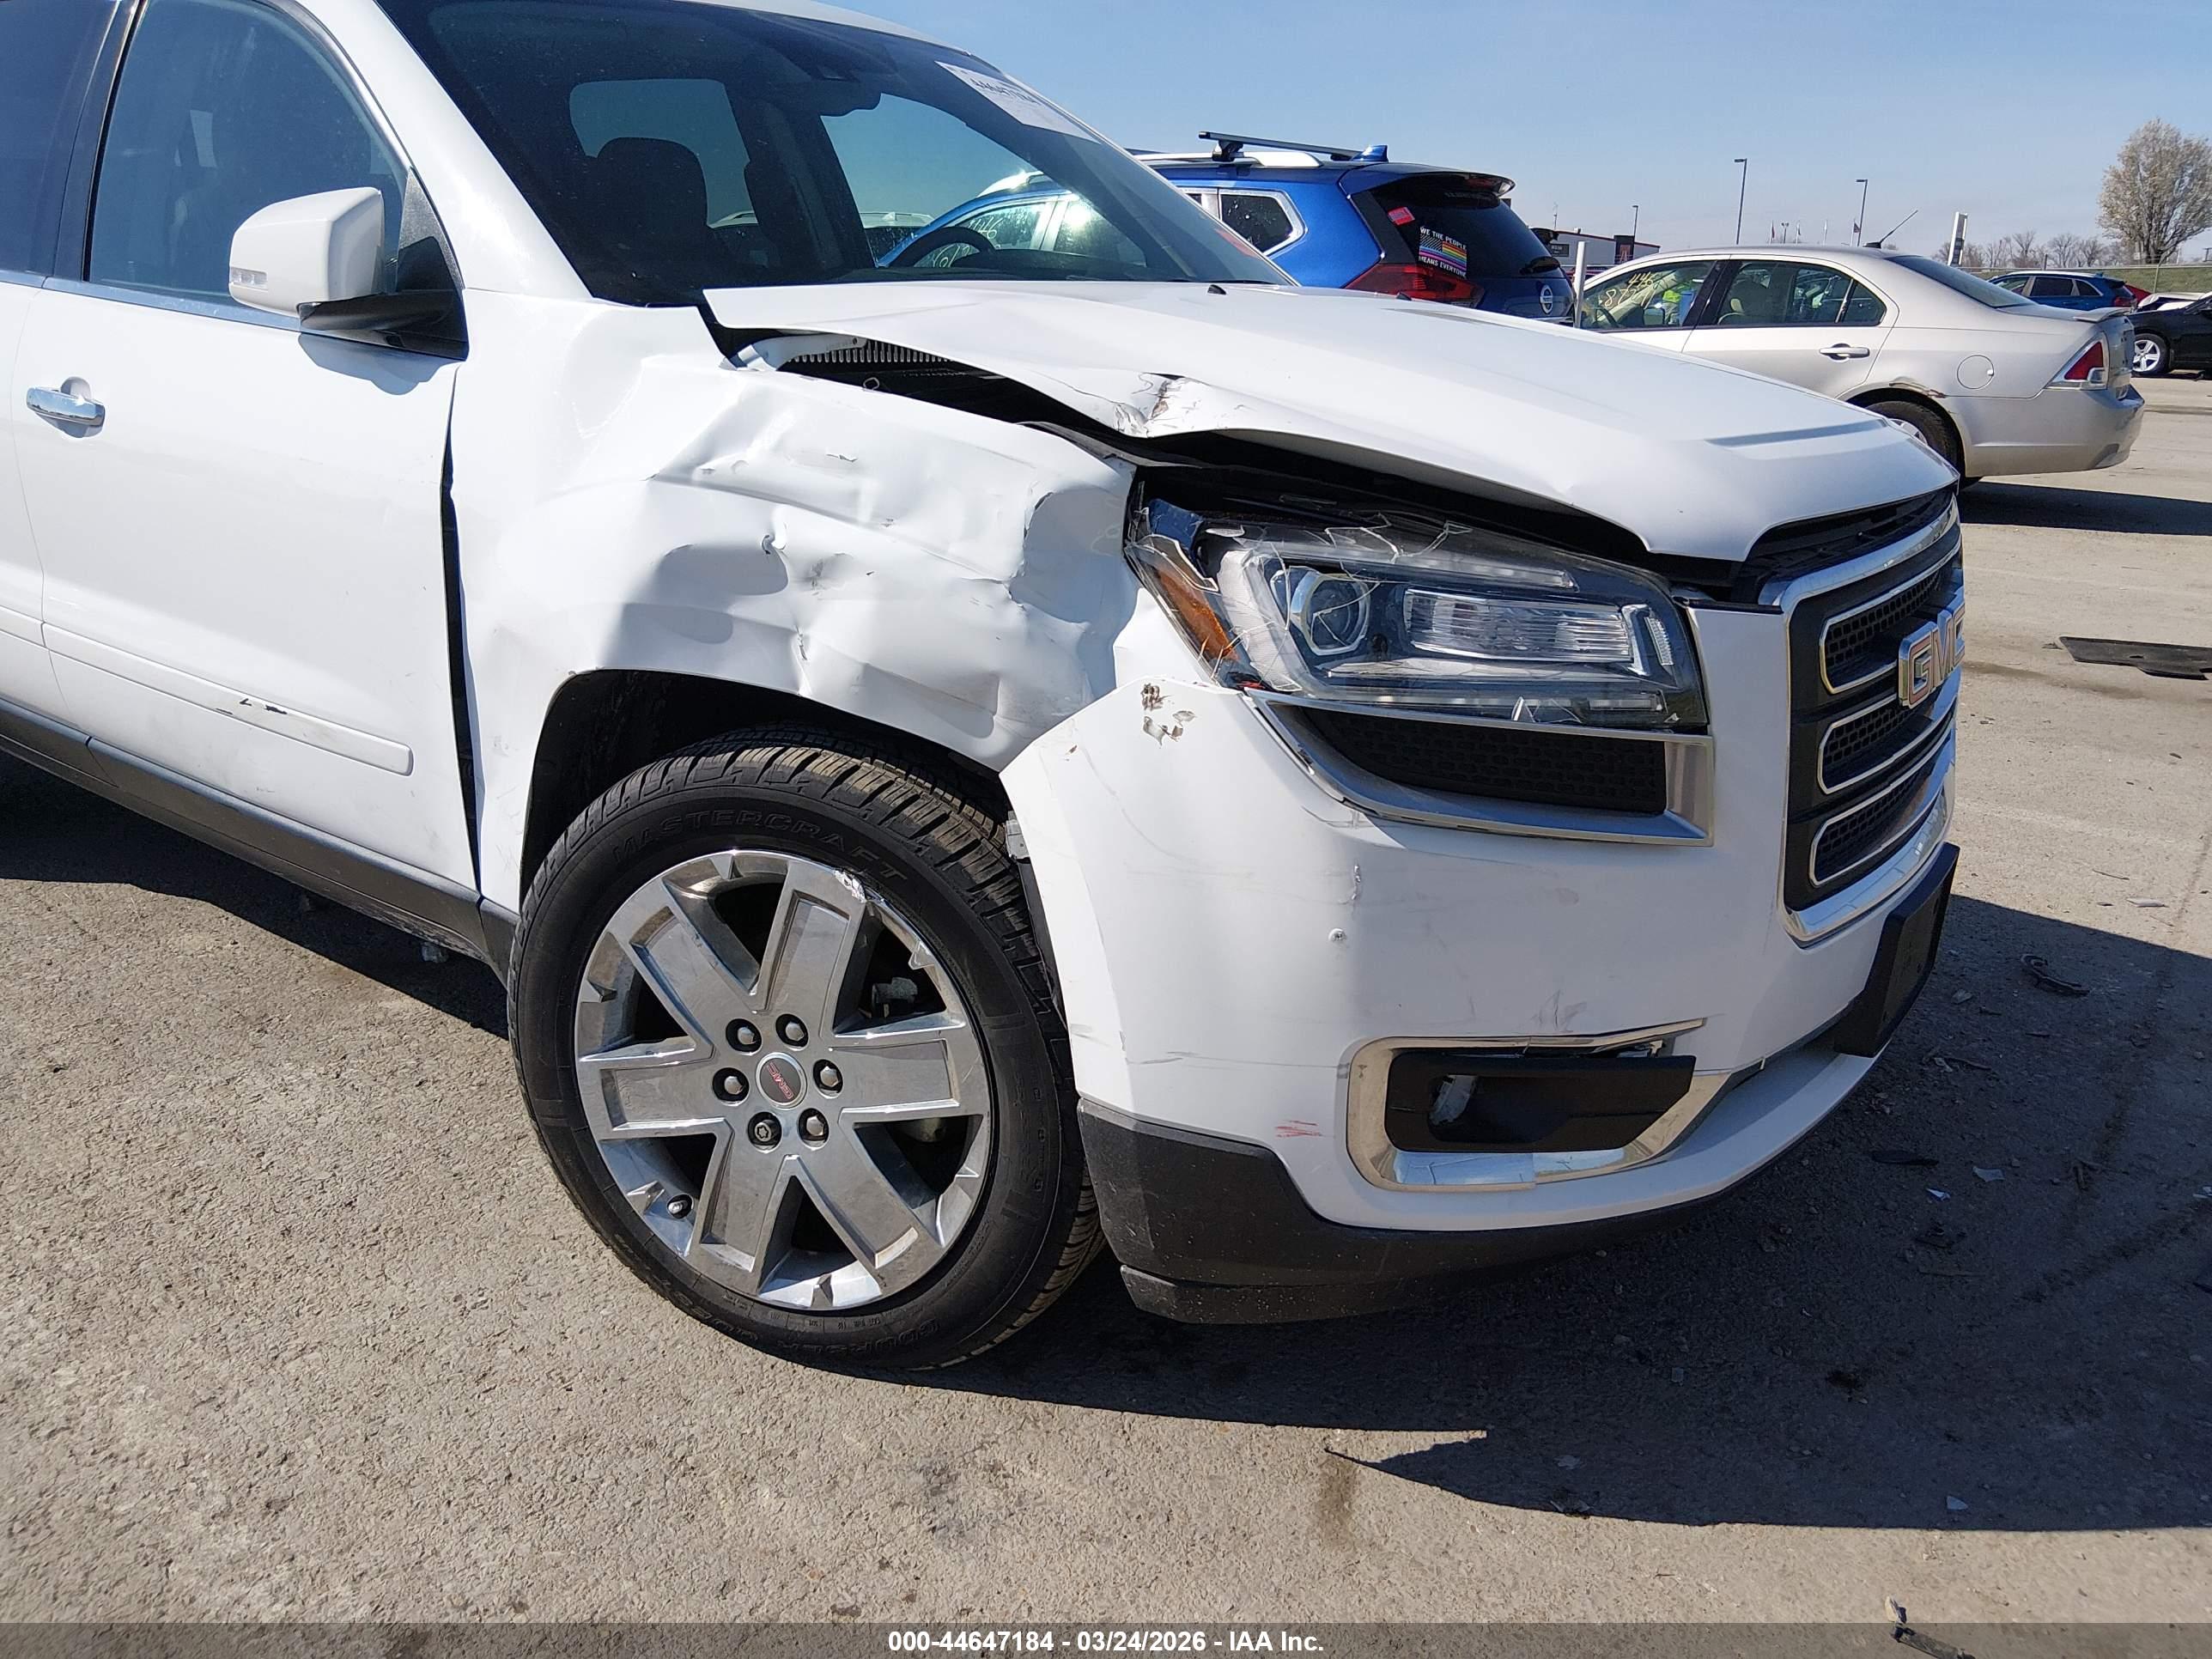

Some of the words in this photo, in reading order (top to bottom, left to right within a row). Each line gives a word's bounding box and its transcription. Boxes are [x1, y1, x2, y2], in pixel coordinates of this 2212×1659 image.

[1419, 226, 1431, 236] WE
[1431, 230, 1444, 240] THE
[1445, 235, 1468, 250] PEOPLE
[1419, 255, 1438, 266] MEANS
[1439, 261, 1468, 278] EVERYONE
[611, 810, 908, 881] MASTERCRAFT
[766, 1061, 794, 1099] GMC
